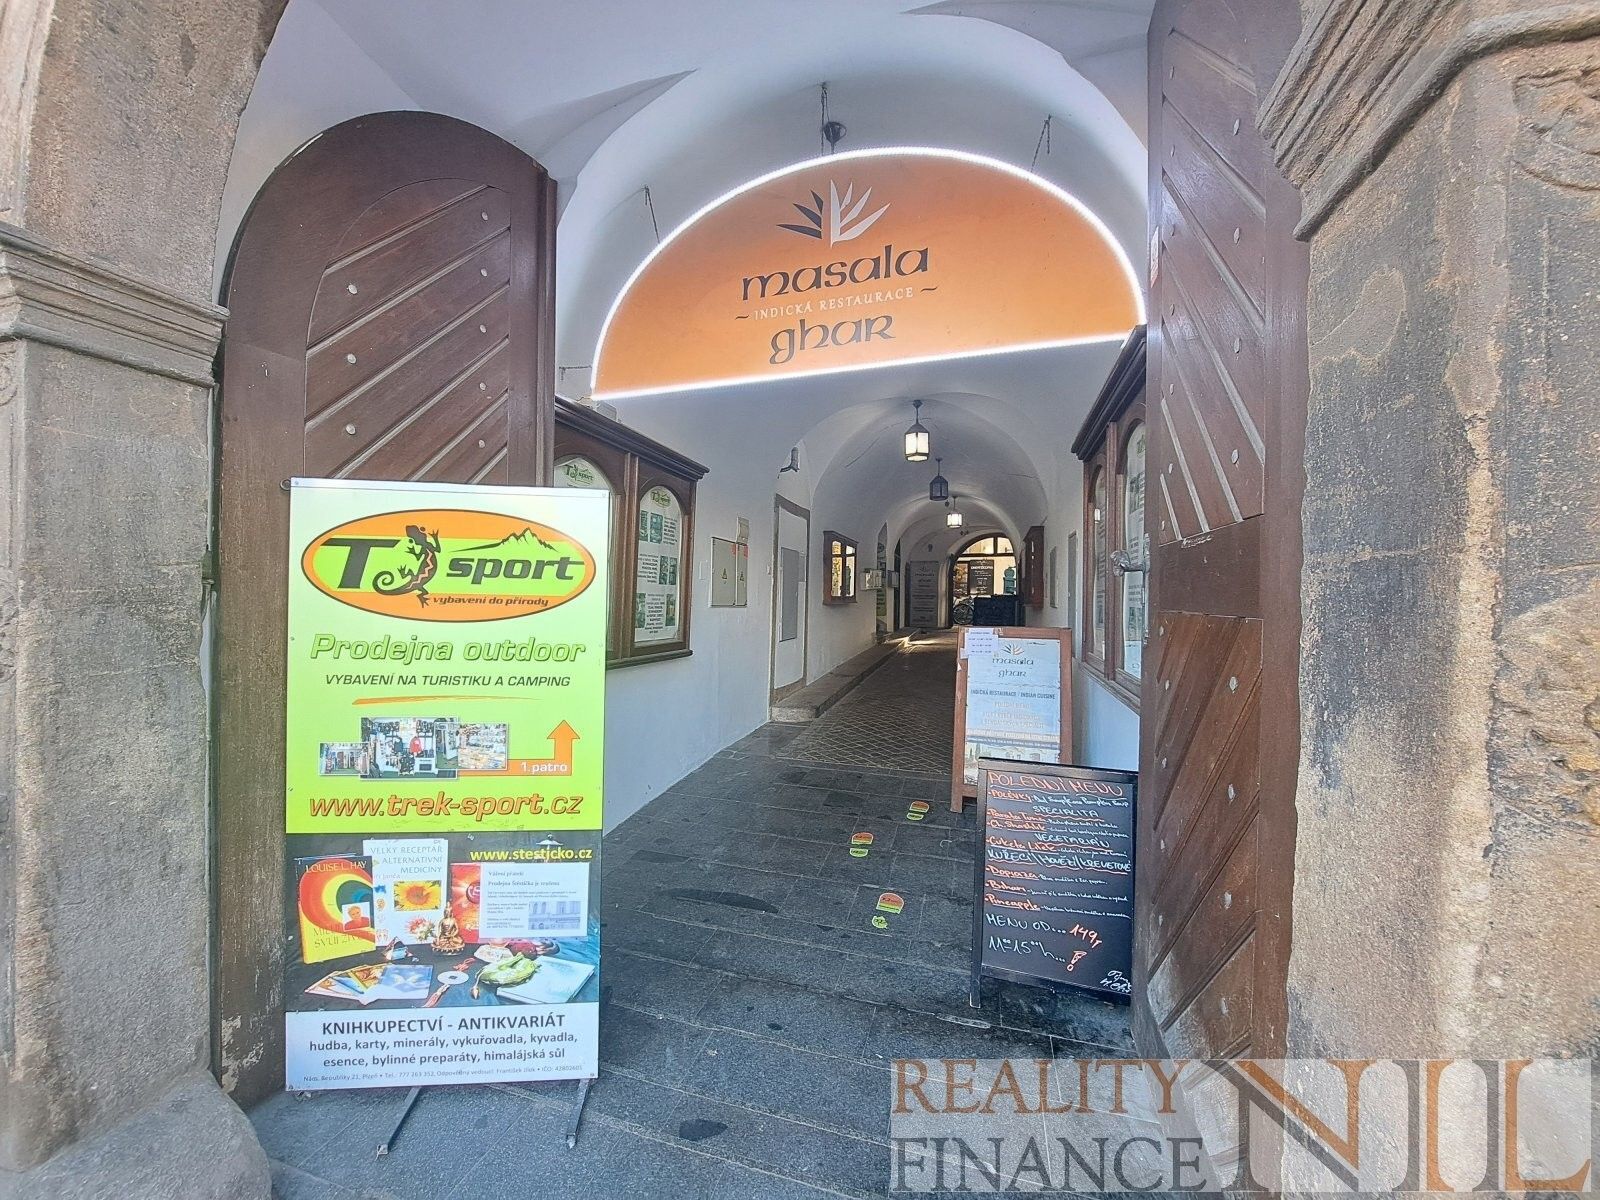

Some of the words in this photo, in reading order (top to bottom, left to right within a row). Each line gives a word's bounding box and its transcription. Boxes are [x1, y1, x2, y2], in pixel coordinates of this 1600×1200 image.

[741, 244, 929, 301] masala
[754, 300, 813, 320] INDICKÁ
[819, 286, 914, 311] RESTAURACE
[446, 556, 585, 585] sport
[432, 596, 488, 607] vybavení
[489, 597, 504, 606] do
[505, 596, 549, 608] přírody
[310, 633, 453, 666] Prodejna
[462, 637, 586, 662] outdoor
[325, 673, 394, 686] VYBAVENÍ
[397, 676, 417, 686] NA
[422, 675, 492, 687] TURISTIKU
[494, 677, 505, 687] A
[507, 676, 571, 687] CAMPING
[988, 770, 1067, 792] POLEDNÍ
[1068, 779, 1123, 797] MENU
[309, 791, 584, 822] www.trek-sport.cz
[305, 861, 340, 874] LOUISE
[350, 860, 368, 869] HAY
[382, 856, 443, 865] ALTERNATIVNÍ
[985, 913, 1028, 930] MENU
[322, 1015, 443, 1035] KNIHKUPECTVÍ
[457, 1012, 566, 1032] ANTIKVARIÁT
[309, 1036, 352, 1053] hudba,
[355, 1035, 390, 1052] karty,
[393, 1033, 449, 1050] minerály,
[452, 1031, 527, 1049] vykuřovadla,
[530, 1030, 578, 1045] kyvadla,
[322, 1055, 368, 1069] esence,
[372, 1049, 416, 1067] bylinné
[419, 1050, 481, 1065] preparáty,
[484, 1047, 546, 1063] himalájská
[548, 1047, 566, 1059] sůl
